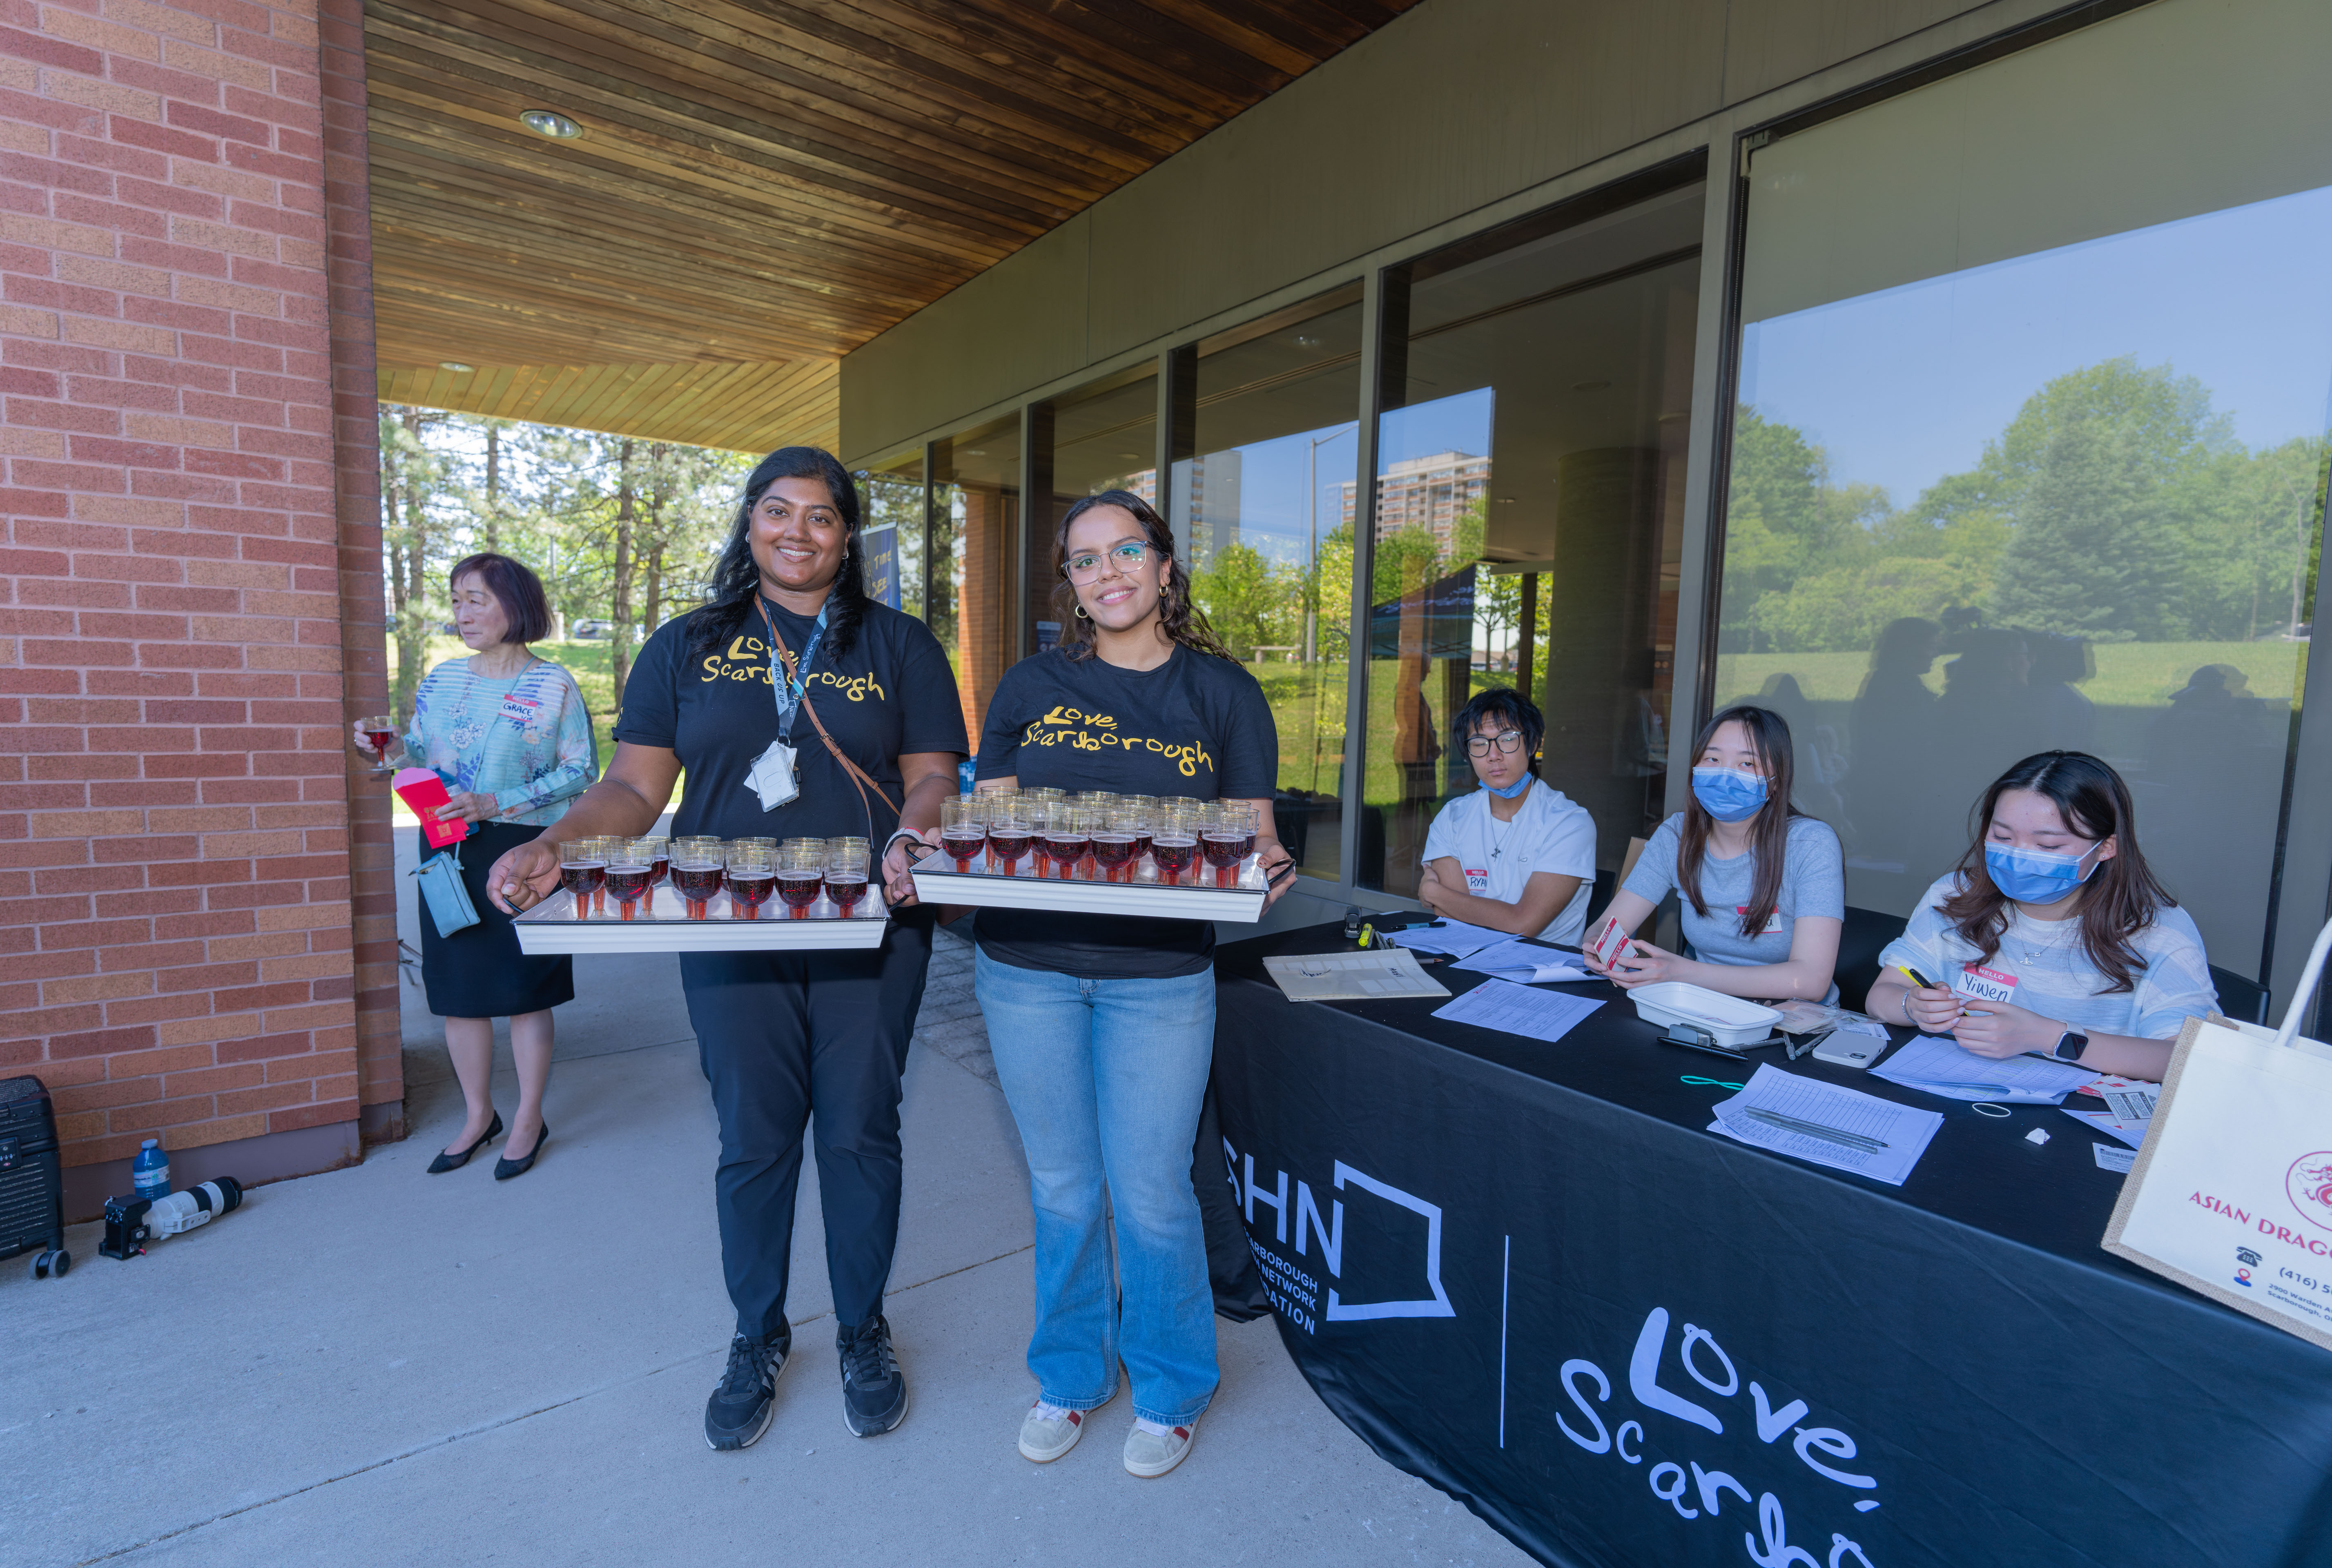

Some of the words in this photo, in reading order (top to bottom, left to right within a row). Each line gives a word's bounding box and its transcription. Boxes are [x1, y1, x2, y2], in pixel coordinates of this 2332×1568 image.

[774, 663, 782, 682] BACK
[777, 683, 784, 693] US
[778, 695, 785, 704] UP
[503, 702, 533, 716] GRACE
[1044, 706, 1118, 730] Love,
[1021, 721, 1213, 776] Scarborough
[1601, 926, 1611, 943] HELLO
[1612, 945, 1622, 962] HELLO
[1978, 968, 2004, 980] HELLO
[1965, 973, 2008, 1002] Yiwen
[2123, 1097, 2137, 1115] ATTENTION
[1223, 1135, 1343, 1278] SHN
[2188, 1191, 2251, 1225] ASIAN
[2258, 1218, 2332, 1260] DRAG
[1262, 1263, 1316, 1312] NETWORK
[2279, 1267, 2317, 1290] (416)
[2322, 1284, 2332, 1295] 5
[1258, 1271, 1315, 1335] DATION
[2267, 1290, 2321, 1318] Scarborough,
[2269, 1283, 2288, 1295] 2900
[2290, 1292, 2322, 1309] Warden
